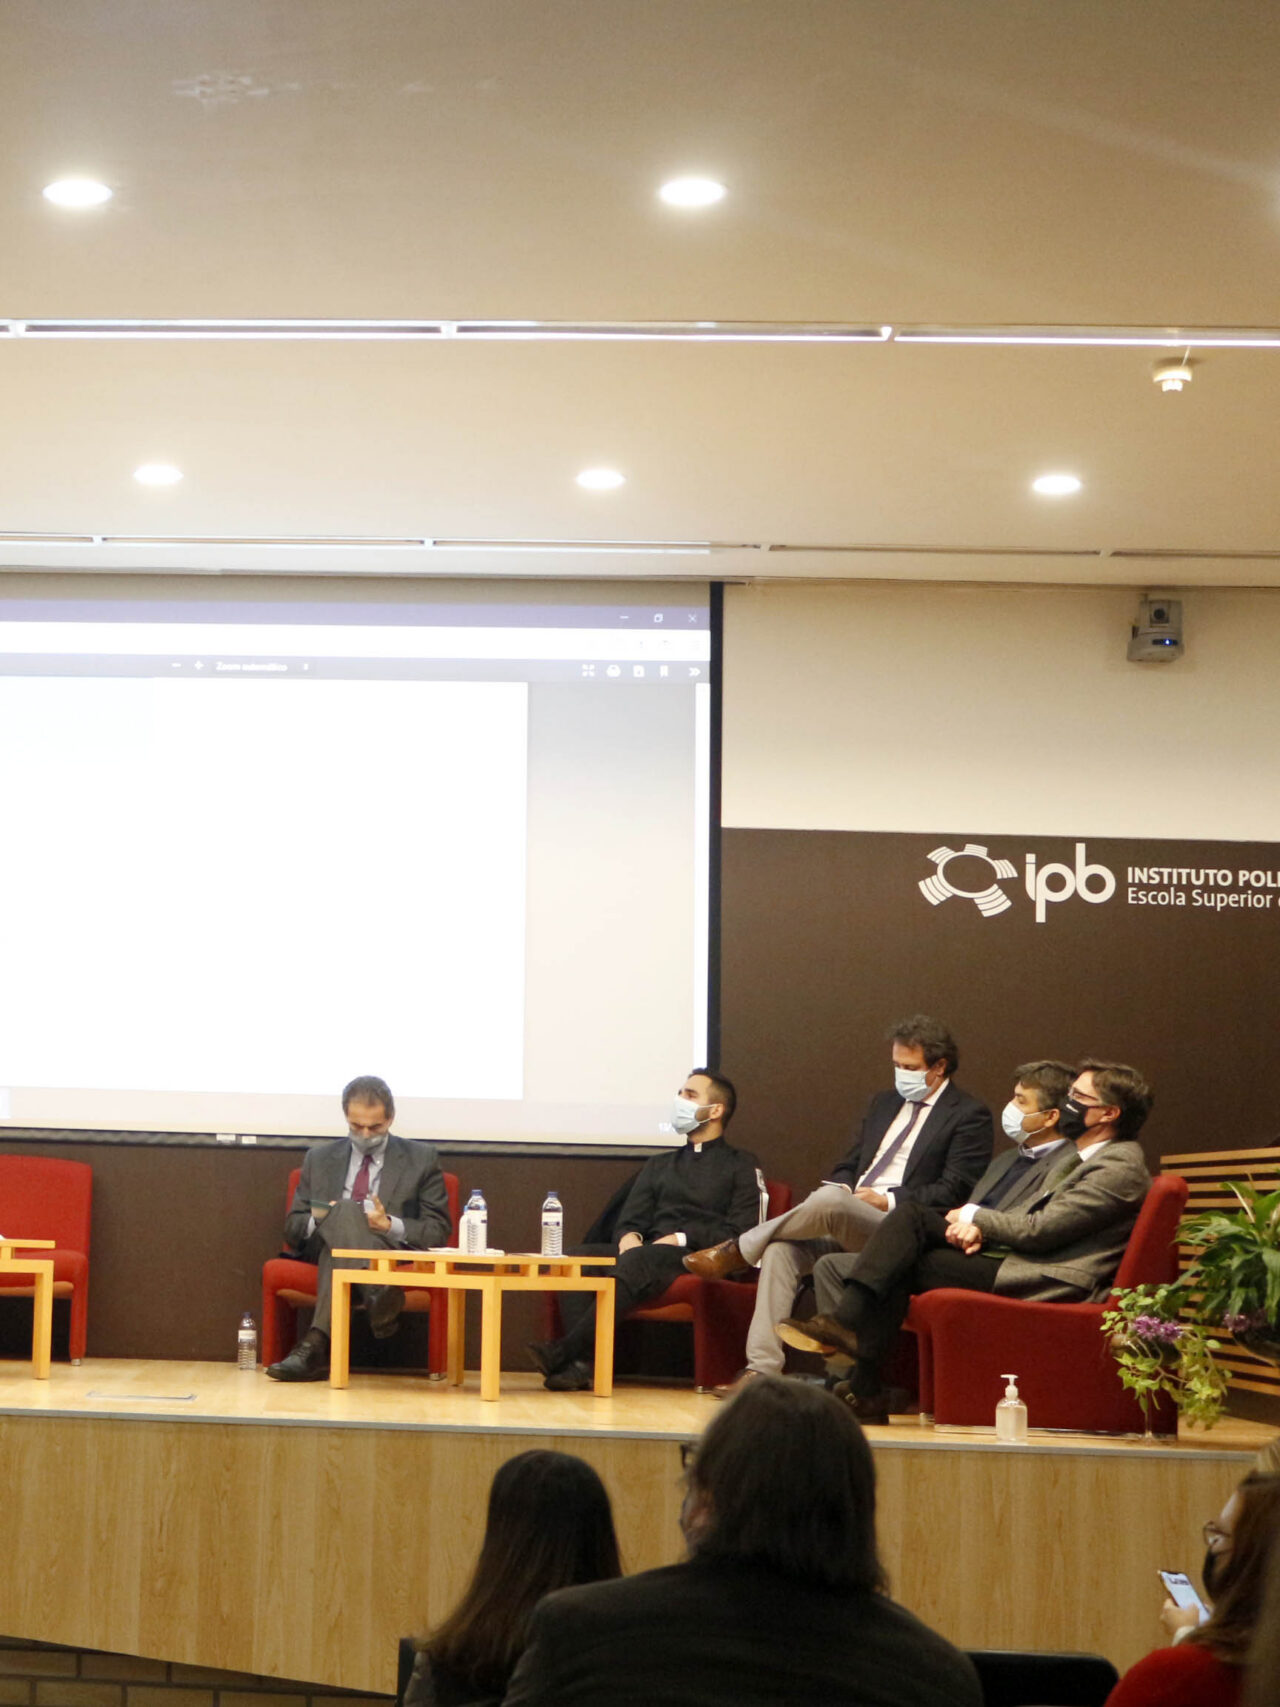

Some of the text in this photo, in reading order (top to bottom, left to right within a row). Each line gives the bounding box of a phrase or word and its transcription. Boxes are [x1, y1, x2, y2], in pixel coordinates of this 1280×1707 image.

[216, 661, 241, 671] Zoom
[1025, 842, 1116, 923] ipb
[1127, 866, 1233, 887] INSTITUTO
[1127, 886, 1186, 906] Escola
[1191, 889, 1273, 912] Superior
